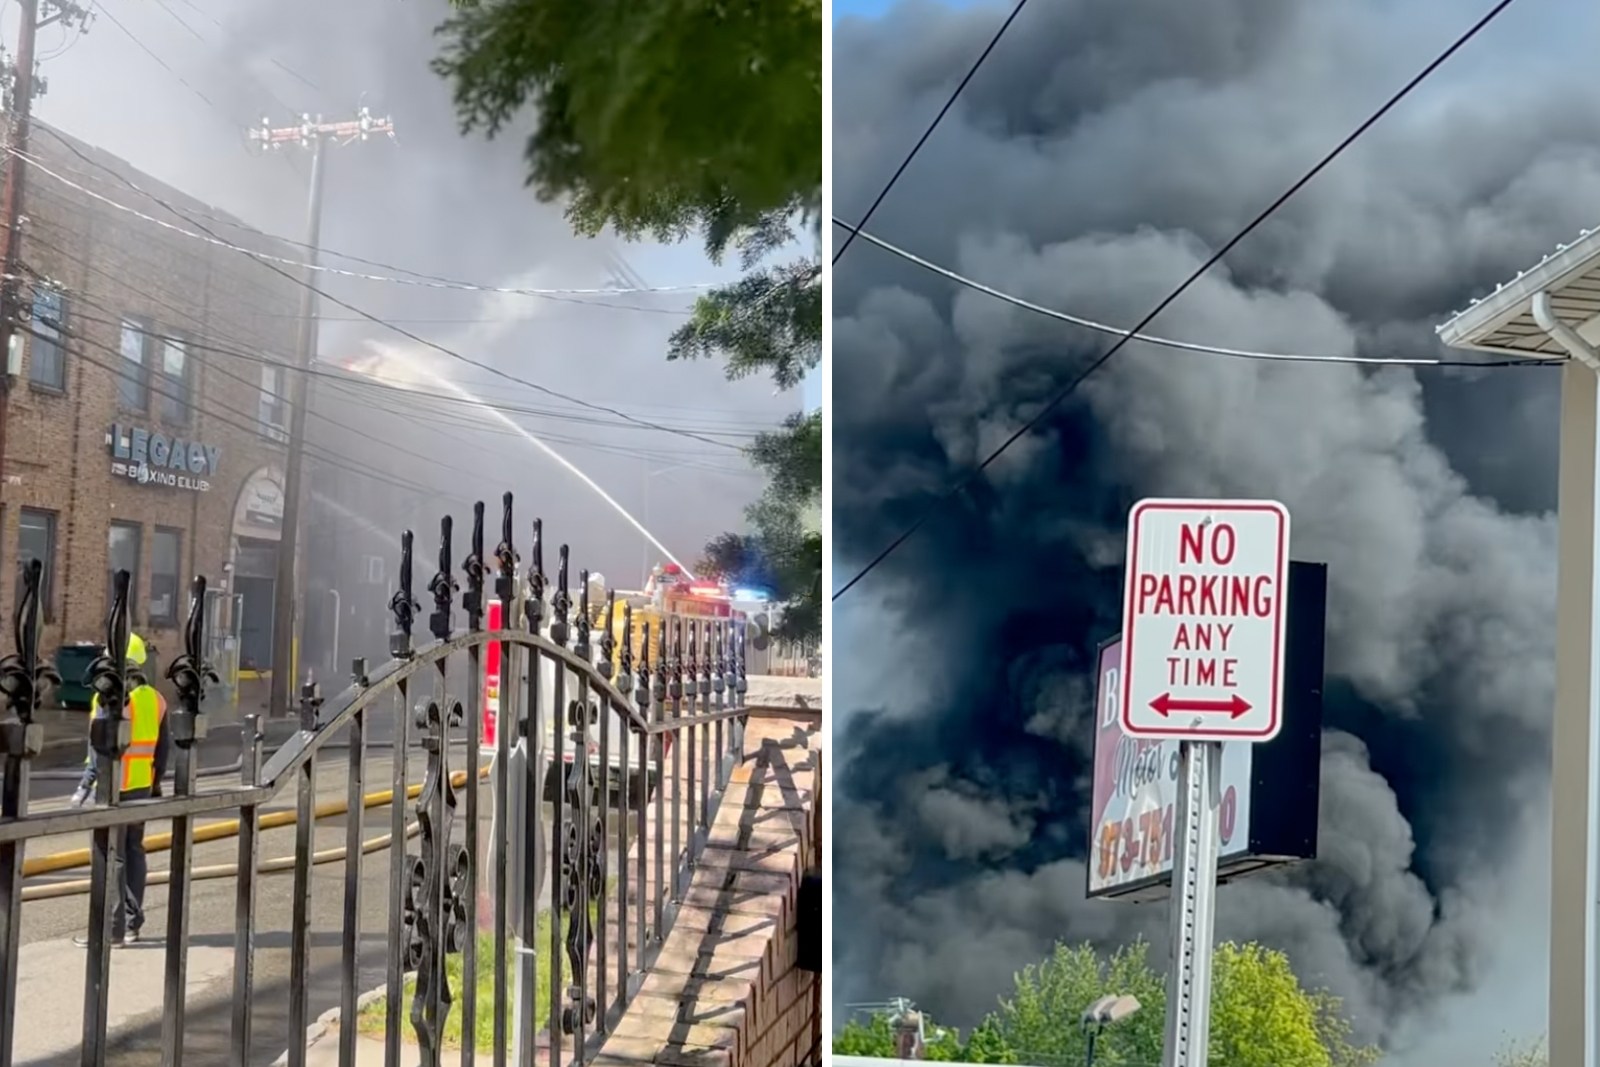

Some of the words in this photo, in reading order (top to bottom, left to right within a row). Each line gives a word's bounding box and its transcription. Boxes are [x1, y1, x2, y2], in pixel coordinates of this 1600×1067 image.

[112, 423, 220, 476] LEGACY
[178, 476, 210, 491] CLUB
[1179, 523, 1235, 565] NO
[1138, 573, 1272, 618] PARKING
[1173, 622, 1234, 652] ANY
[1166, 657, 1238, 687] TIME
